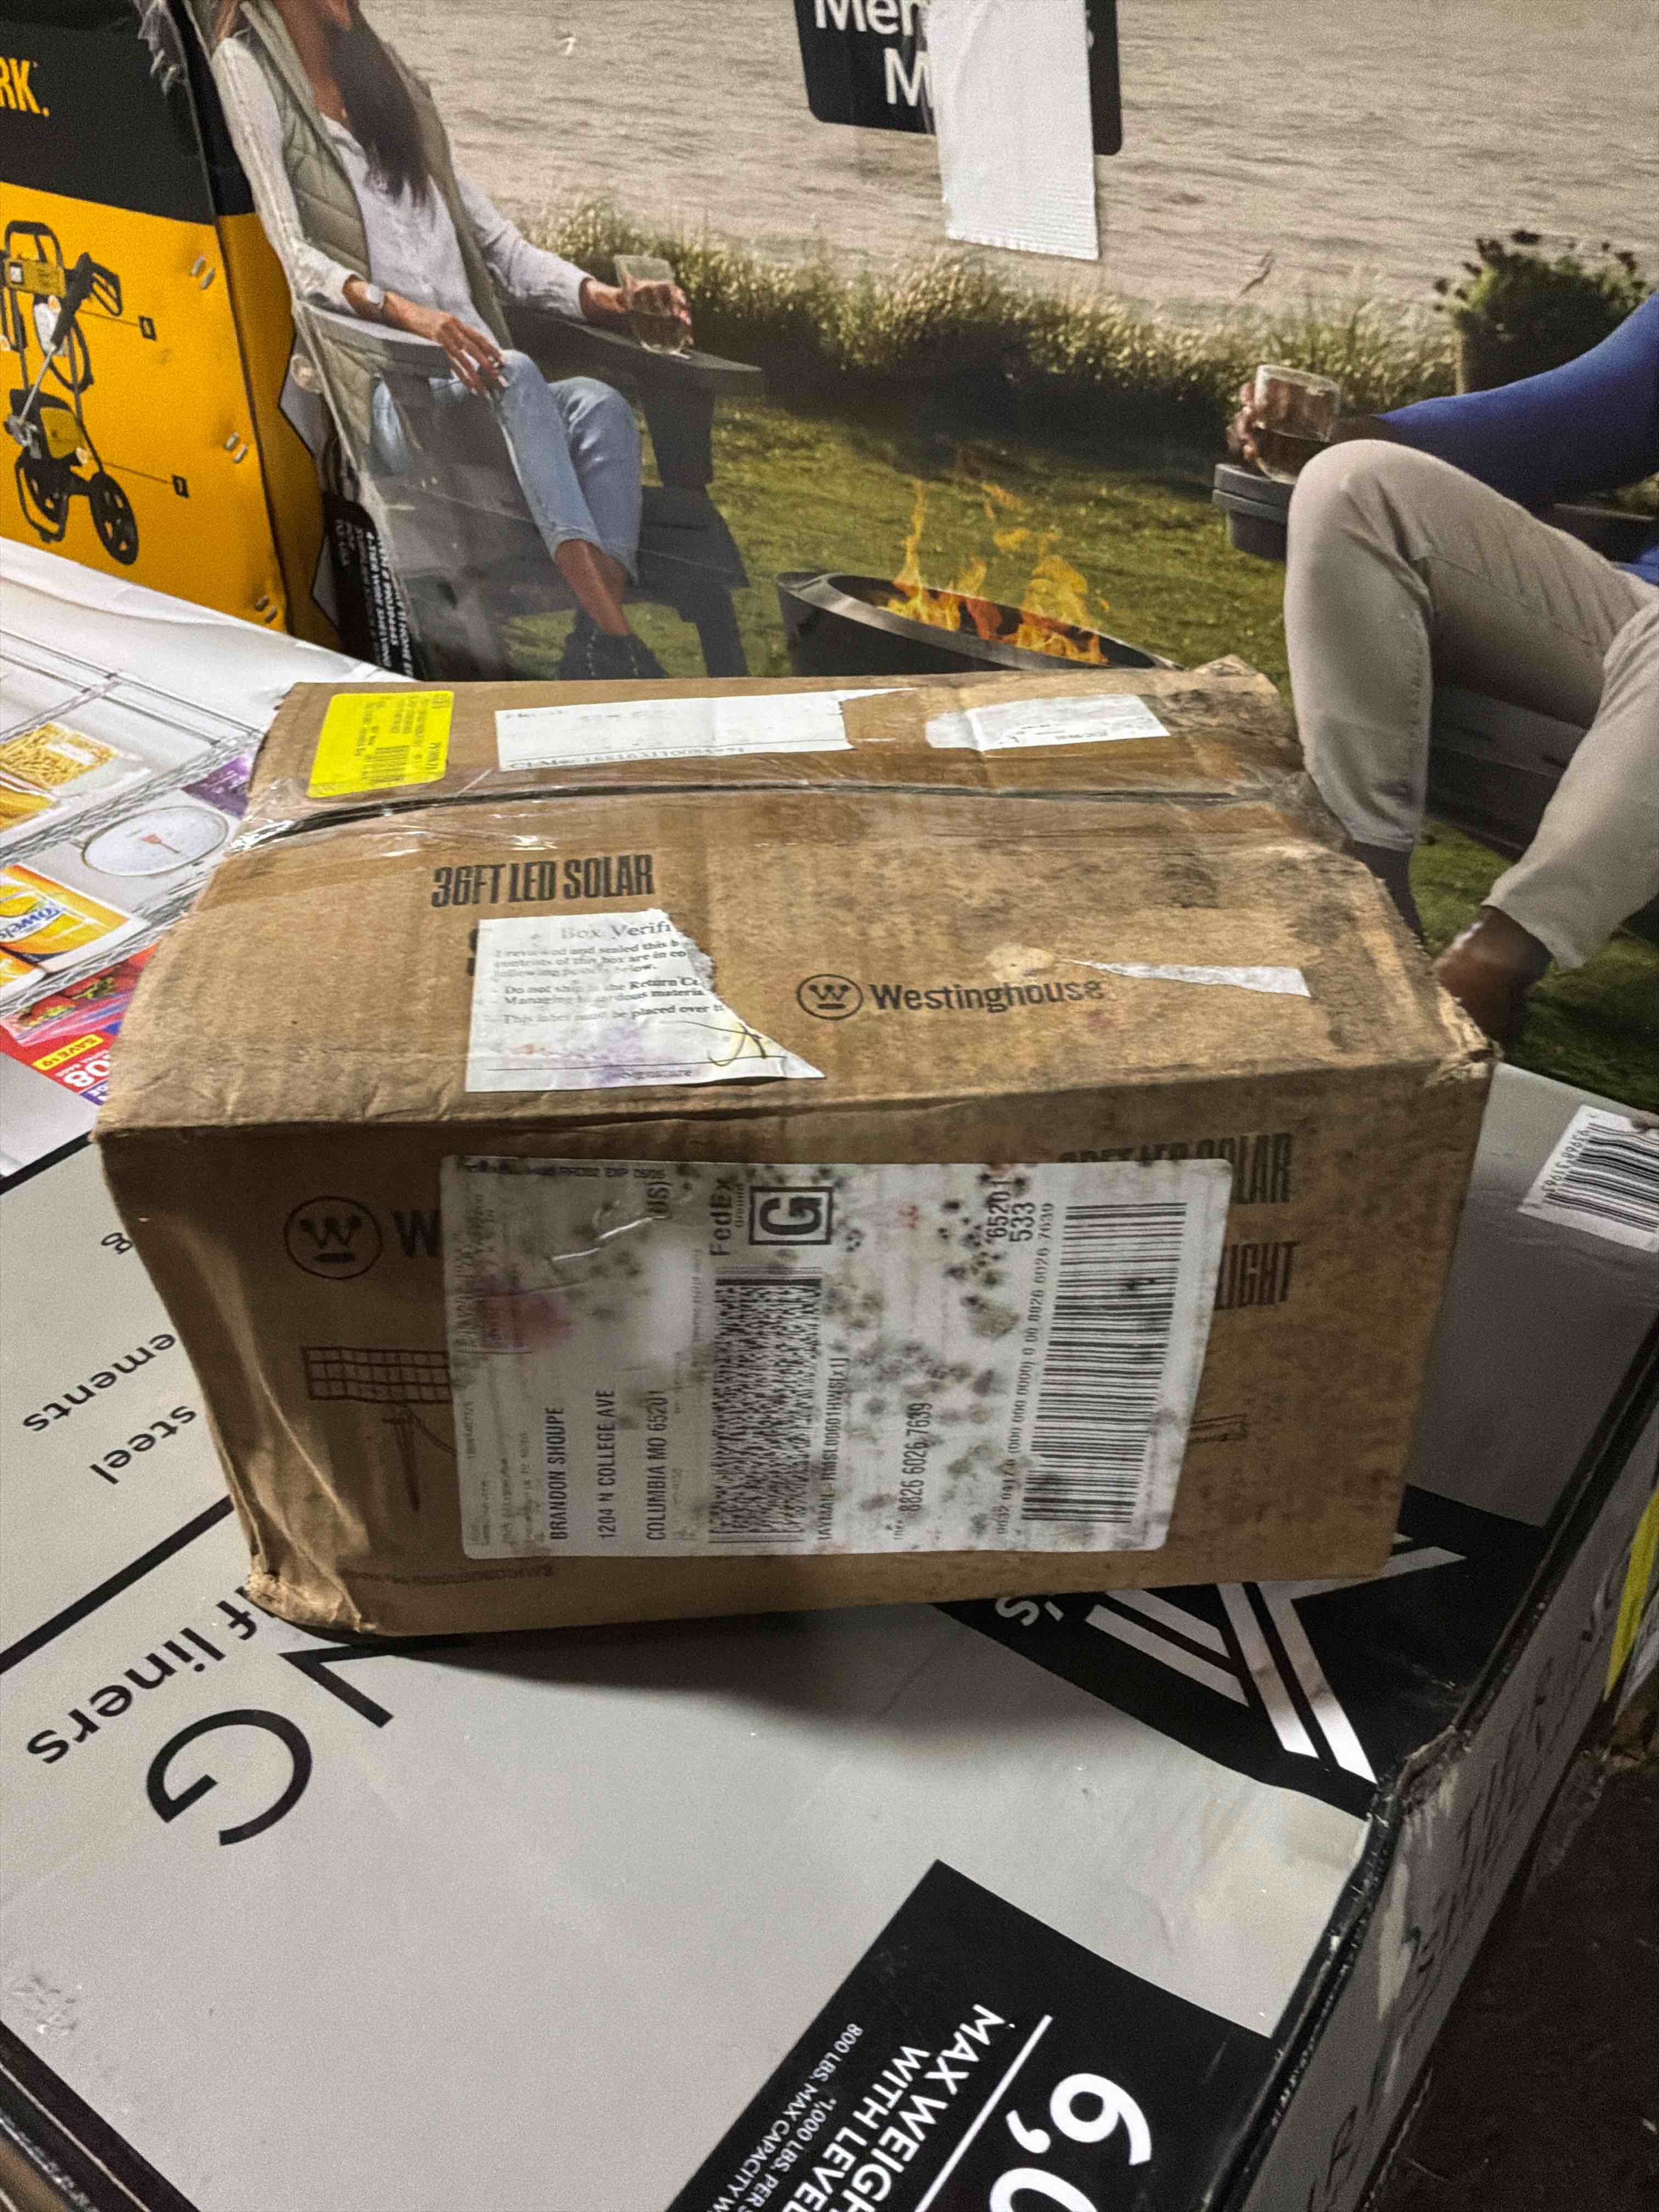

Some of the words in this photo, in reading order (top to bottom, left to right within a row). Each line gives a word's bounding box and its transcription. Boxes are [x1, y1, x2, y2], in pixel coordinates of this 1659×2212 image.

[508, 860, 558, 902] LED
[563, 854, 655, 900] SOLAR
[561, 927, 601, 940] Box
[630, 1005, 676, 1020] placed
[870, 979, 1105, 1014] Westinghouse
[709, 1178, 733, 1256] FedEx
[759, 1196, 822, 1235] G
[1008, 1201, 1036, 1243] 533
[595, 1390, 615, 1418] AVE
[646, 1390, 668, 1431] 65201
[906, 1402, 933, 1437] 7639
[89, 1404, 196, 1485] steel
[545, 1407, 567, 1464] SHOUPE
[596, 1423, 616, 1486] COLLEGE
[646, 1437, 667, 1460] MO
[902, 1440, 929, 1475] 6026
[549, 1470, 568, 1540] BRANDON
[598, 1492, 615, 1502] N
[646, 1465, 667, 1541] COLUMBIA
[898, 1479, 925, 1513] 8826
[597, 1509, 616, 1539] 1204
[26, 1627, 226, 1764] liners
[833, 2023, 864, 2054] 800
[924, 2004, 1006, 2096] MAX
[782, 2083, 819, 2122] MAX
[852, 2045, 931, 2130] WITH
[727, 2119, 791, 2199] CAPACITY
[769, 2140, 805, 2172] LBS.
[744, 2173, 780, 2208] PER
